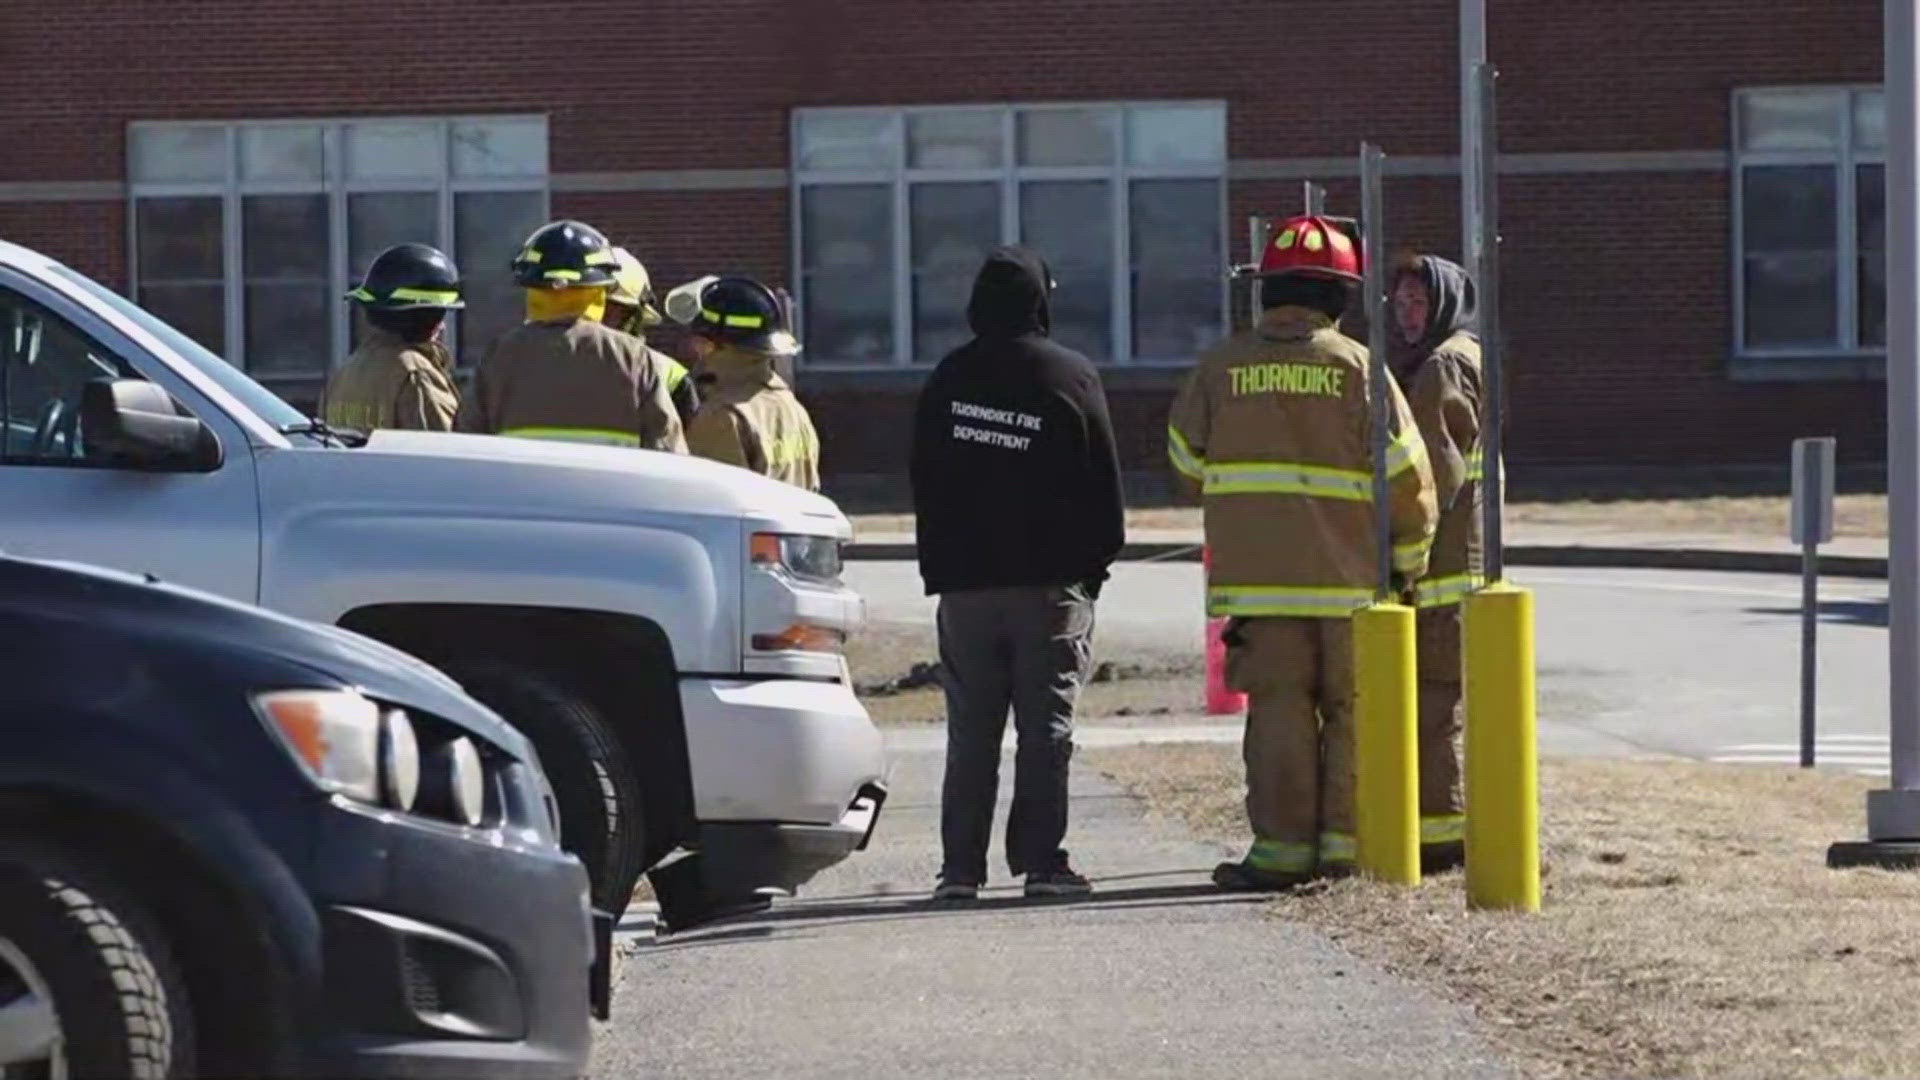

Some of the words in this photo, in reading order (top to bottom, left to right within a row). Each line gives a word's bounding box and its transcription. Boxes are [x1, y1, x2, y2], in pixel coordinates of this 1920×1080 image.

[1227, 364, 1344, 398] THORNDIKE
[951, 401, 1015, 425] THORNDIKE
[1016, 413, 1042, 431] FIRE
[953, 424, 1031, 451] DEPARTMENT
